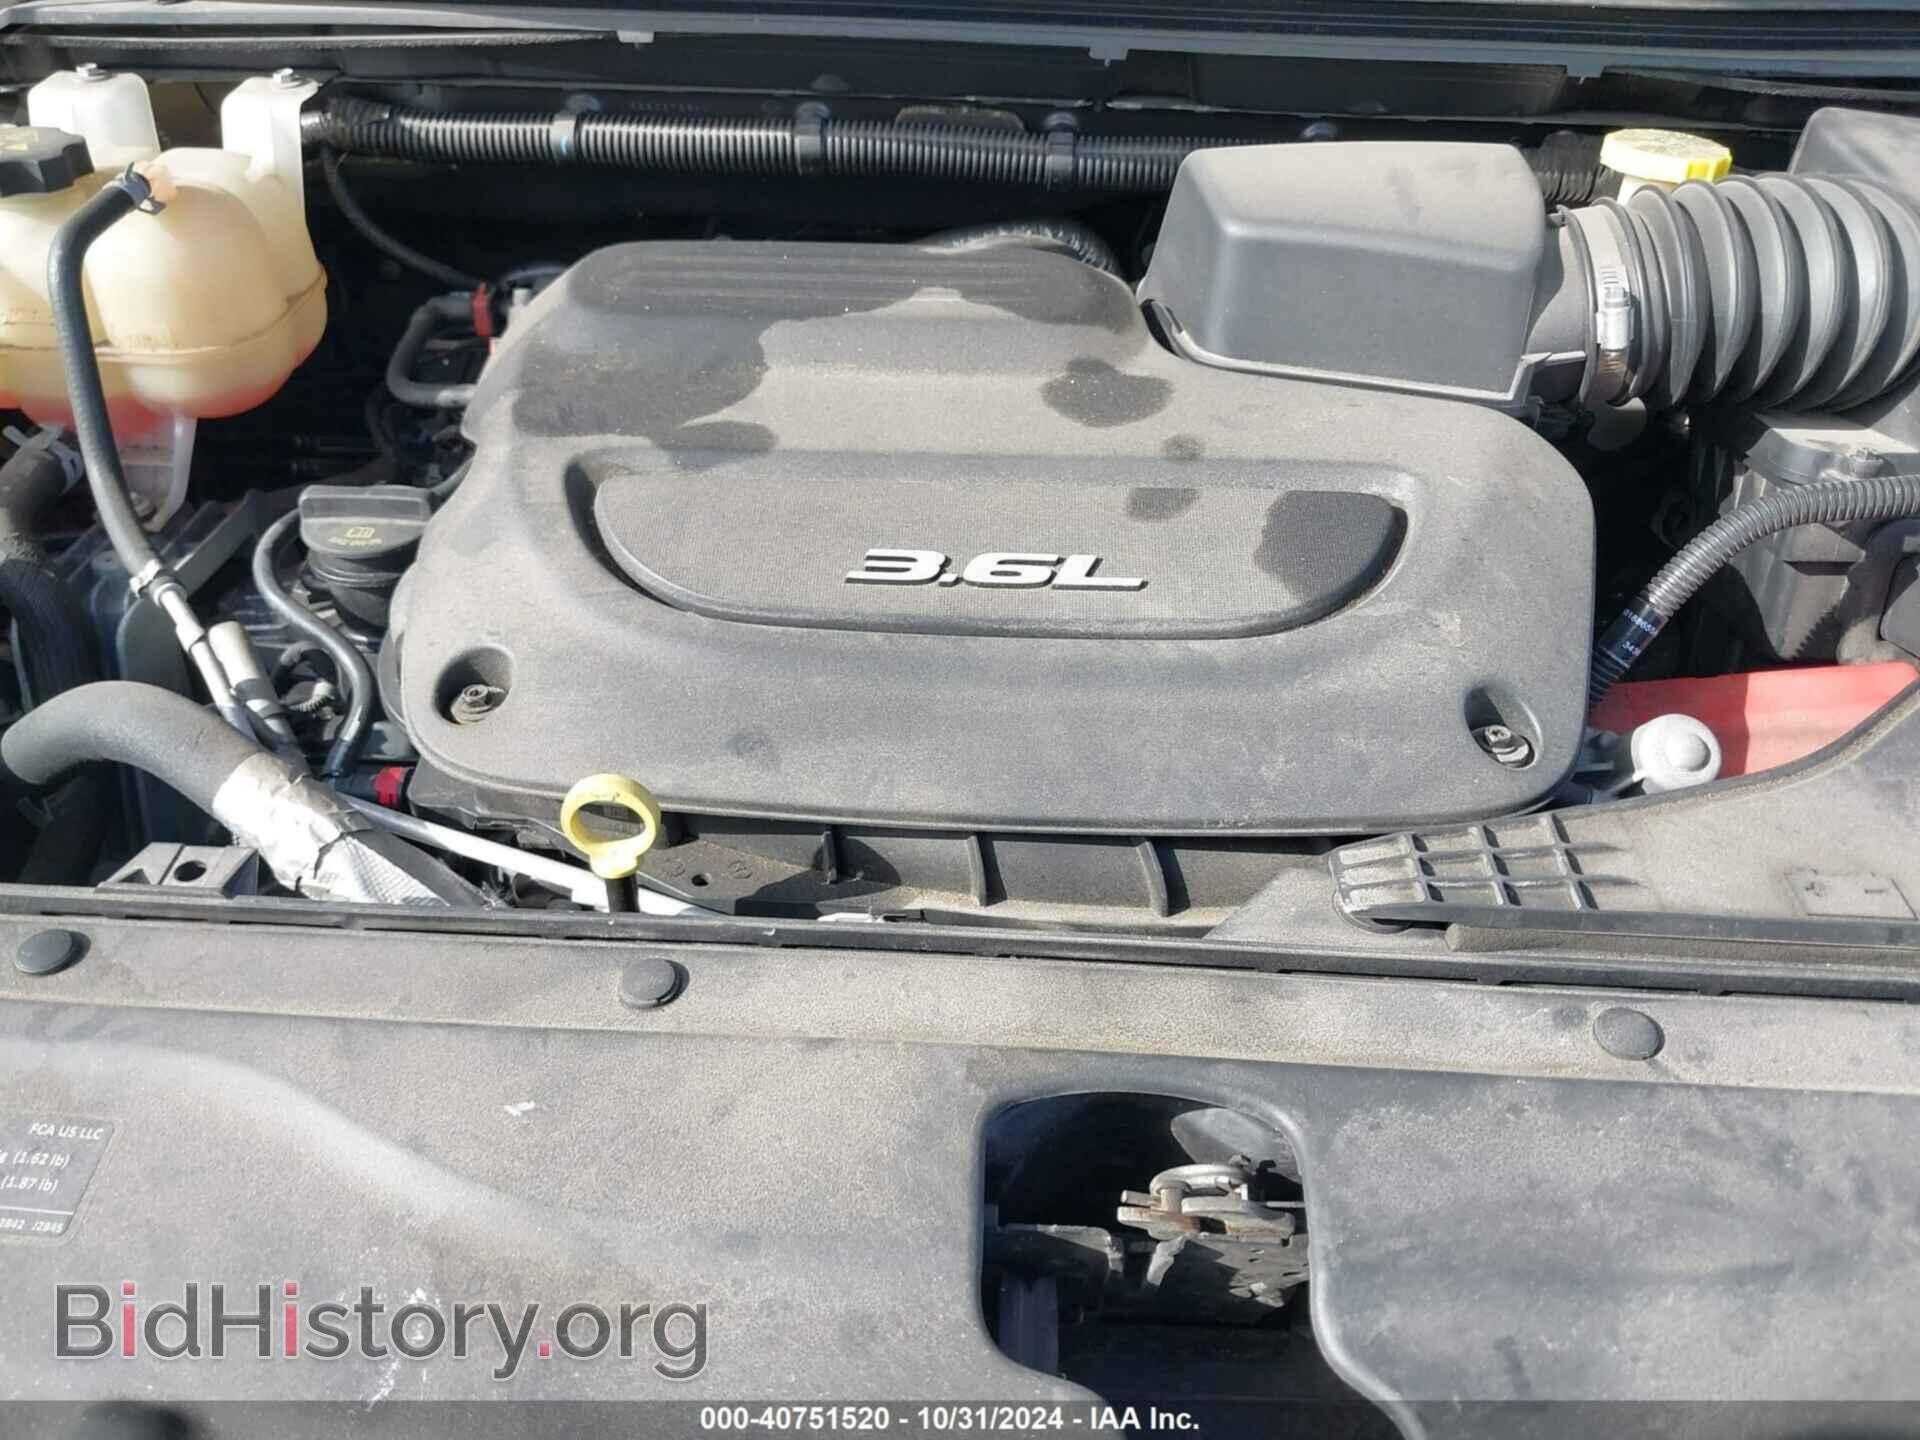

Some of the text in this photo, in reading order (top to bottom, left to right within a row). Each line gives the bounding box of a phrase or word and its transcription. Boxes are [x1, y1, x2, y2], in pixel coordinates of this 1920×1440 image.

[845, 548, 1148, 592] 3.6L
[28, 1122, 104, 1140] FCA US LLC
[50, 1152, 70, 1170] lb)
[0, 1175, 59, 1194] (1.87 lb)
